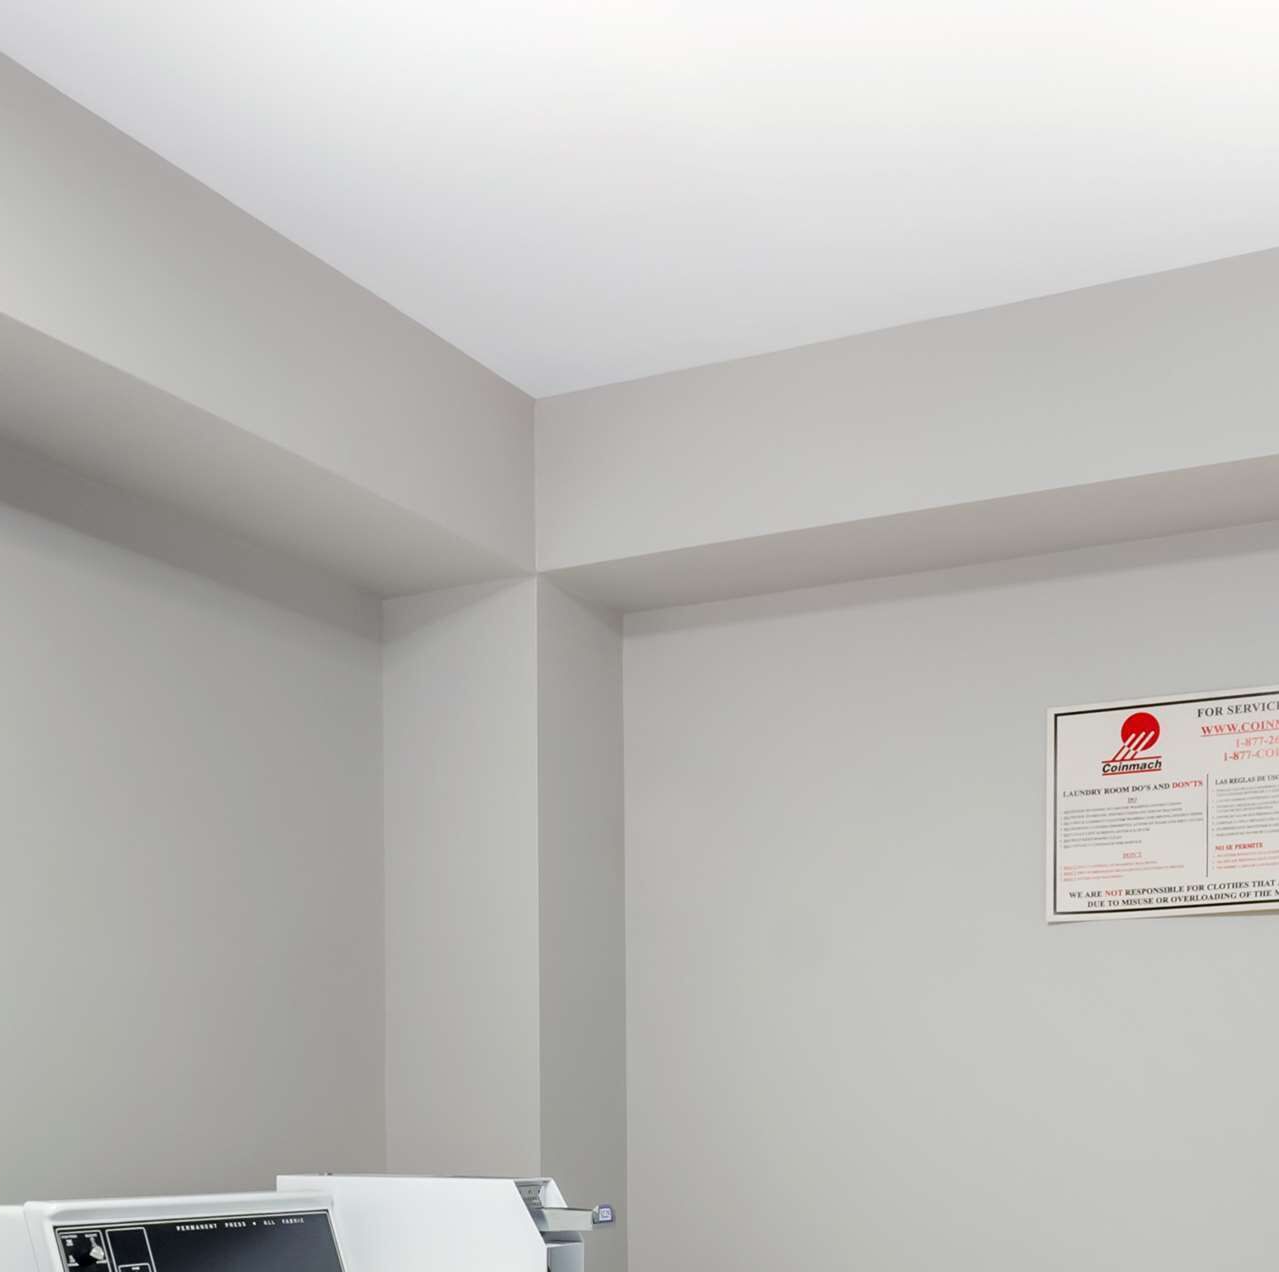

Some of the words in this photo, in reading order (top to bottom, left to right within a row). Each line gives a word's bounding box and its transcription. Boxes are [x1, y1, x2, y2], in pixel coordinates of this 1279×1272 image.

[1197, 707, 1223, 718] FOR
[1102, 759, 1162, 773] Coinmach
[1063, 788, 1101, 798] LAUNDRY
[1104, 785, 1130, 794] ROOM
[1069, 891, 1082, 899] WE
[1085, 890, 1102, 898] ARE
[1105, 889, 1125, 897] NOT
[1125, 885, 1185, 896] RESPONSIBLE
[1186, 884, 1204, 892] FOR
[1207, 880, 1249, 891] CLOTHES
[1252, 878, 1279, 888] THAT
[1088, 900, 1105, 908] DUE
[1108, 899, 1119, 907] TO
[1121, 898, 1154, 906] MISUSE
[1170, 892, 1237, 904] OVERLOADING
[1239, 891, 1252, 899] OF
[1252, 889, 1272, 898] THE
